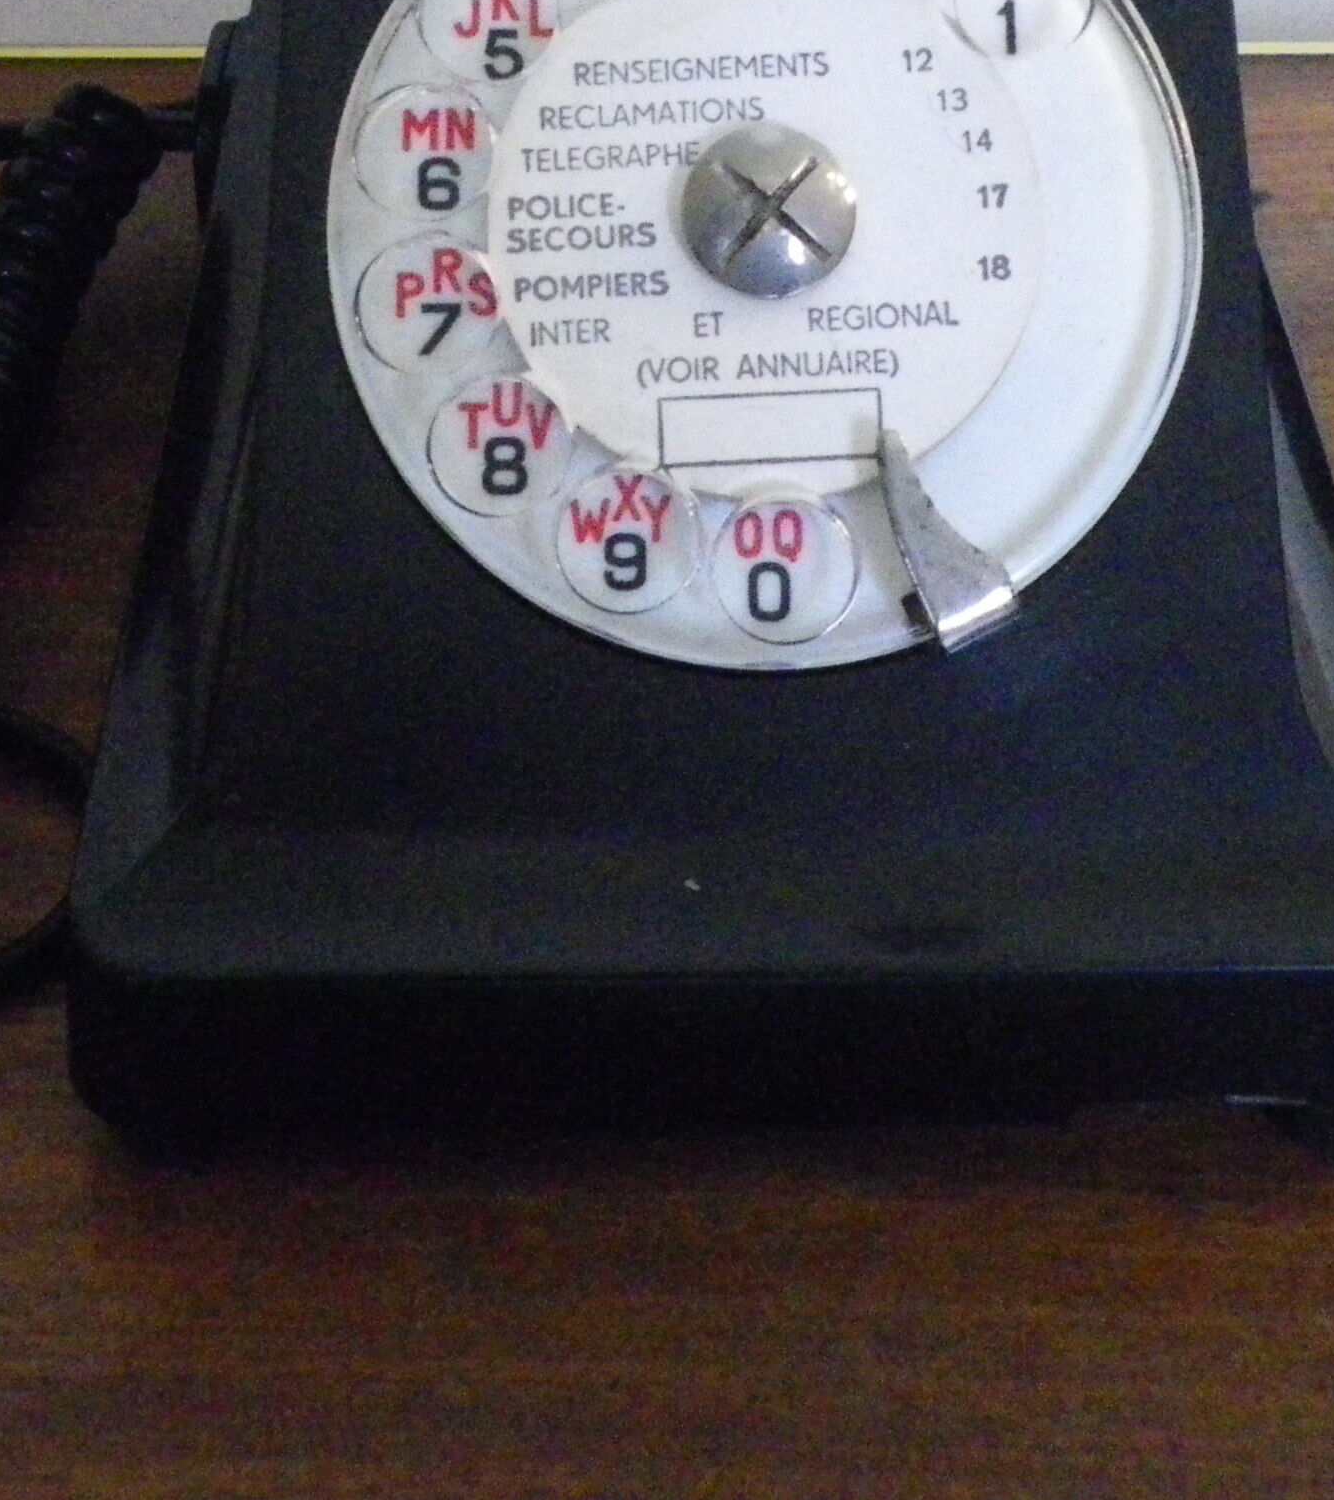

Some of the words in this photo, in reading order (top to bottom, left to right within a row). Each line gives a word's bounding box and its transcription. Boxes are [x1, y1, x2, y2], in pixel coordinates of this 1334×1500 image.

[997, 0, 1018, 55] 1
[484, 30, 524, 80] 5
[574, 52, 830, 85] RENSEIGNEMENTS
[903, 49, 933, 73] 12
[539, 96, 765, 129] RECLAMATIONS
[937, 89, 968, 112] 13
[522, 142, 700, 172] TELEGRAPHE
[962, 129, 992, 153] 14
[418, 157, 460, 210] 6
[978, 184, 1009, 208] 17
[508, 194, 625, 222] POLICE-
[507, 223, 656, 253] SECOURS
[978, 256, 1011, 281] 18
[514, 271, 669, 302] POMPIERS
[420, 303, 462, 357] 7
[530, 319, 609, 346] INTER
[694, 312, 723, 338] ET
[808, 301, 959, 331] REGIONAL
[637, 357, 720, 389] (VOIR
[737, 350, 899, 380] ANNUAIRE)
[482, 437, 527, 496] 8
[604, 533, 646, 590] 9
[748, 563, 791, 622] 0
